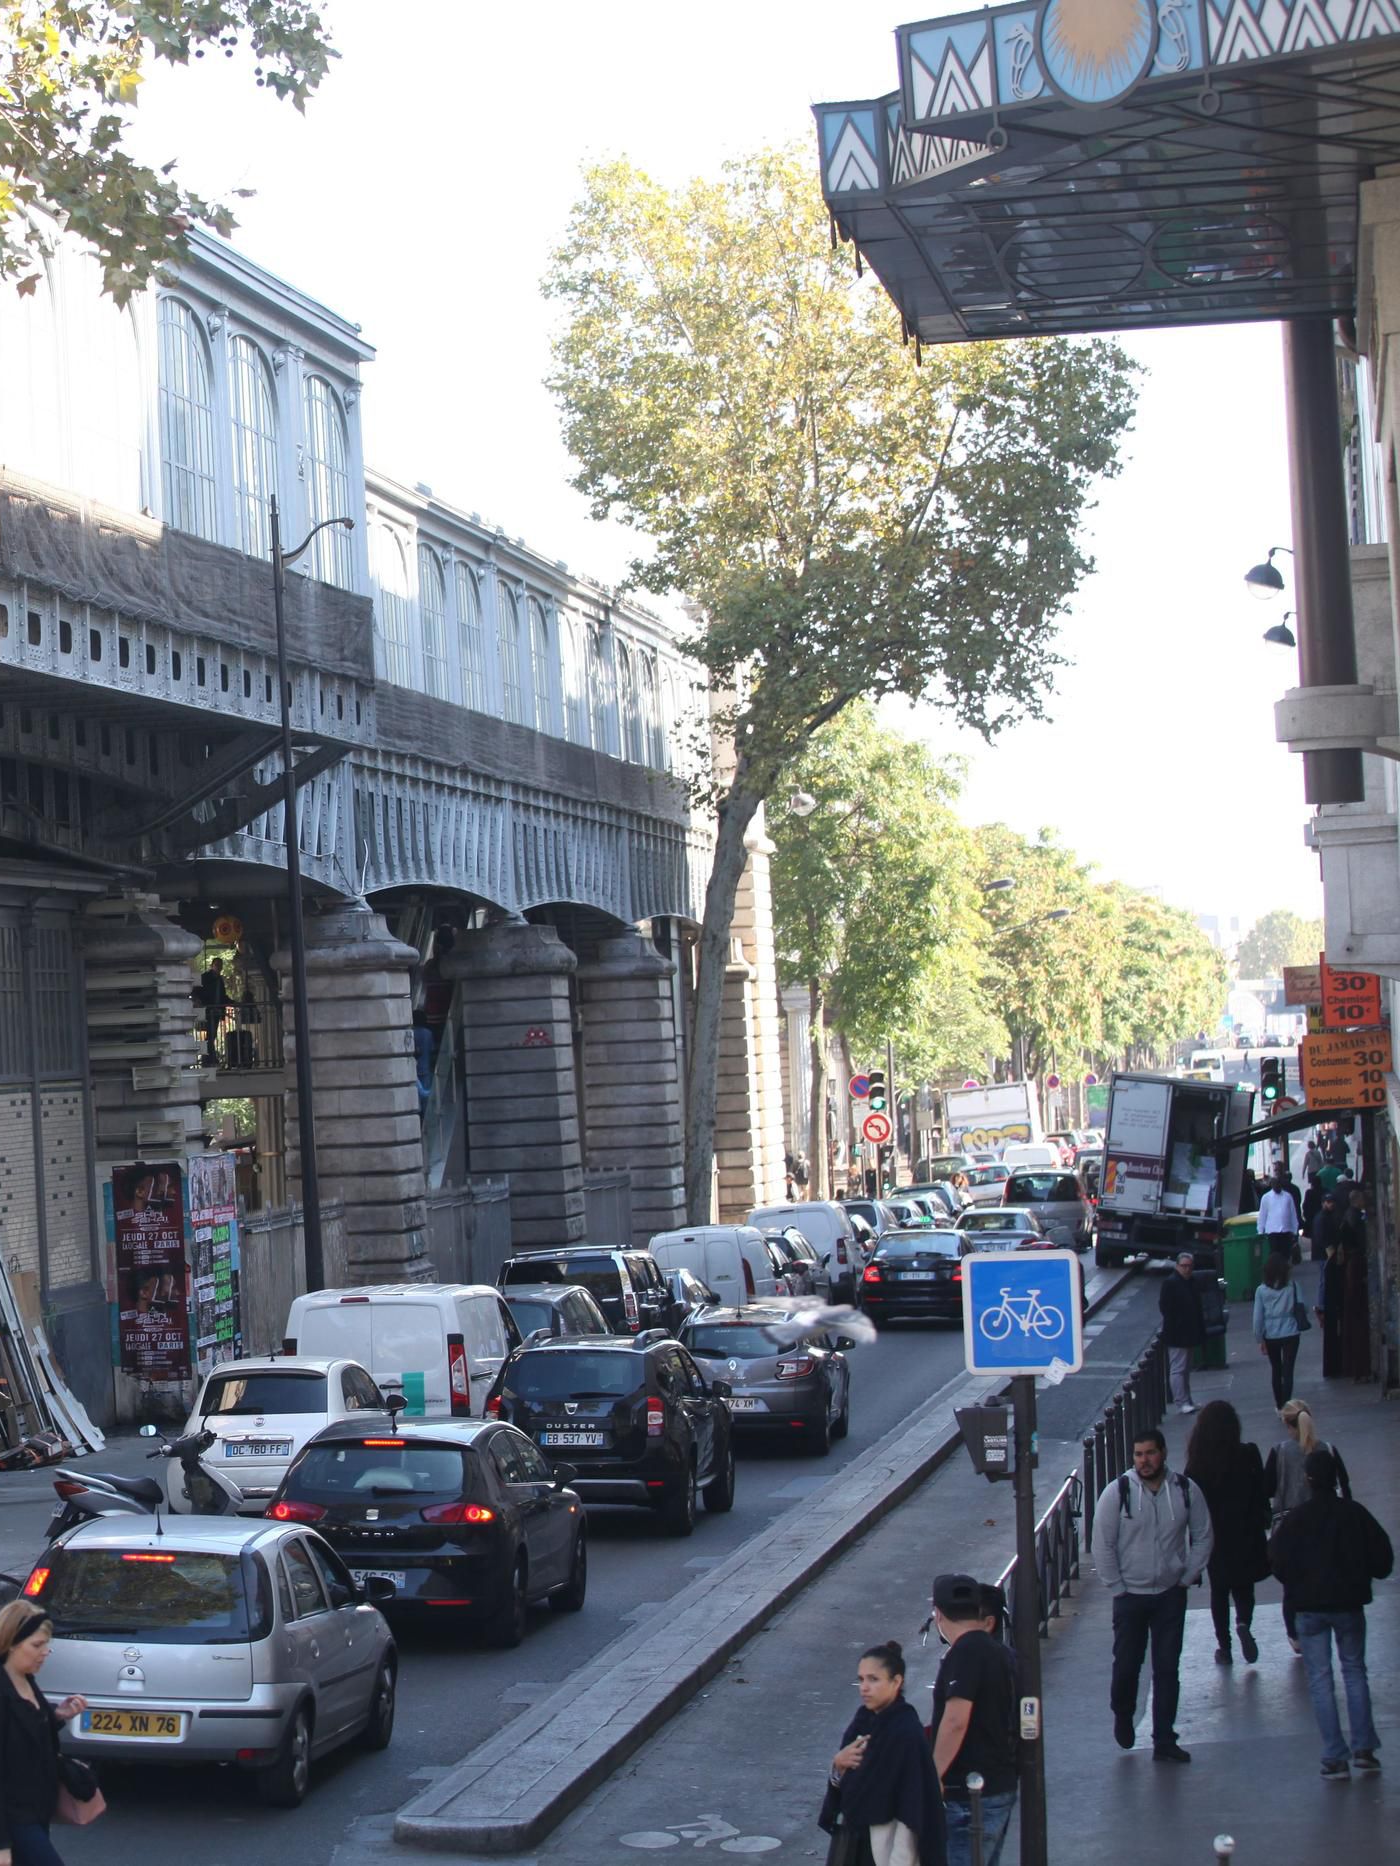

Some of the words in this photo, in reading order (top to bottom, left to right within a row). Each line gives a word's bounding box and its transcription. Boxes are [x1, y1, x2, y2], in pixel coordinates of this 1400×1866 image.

[1327, 1037, 1367, 1052] JAMAIS
[1358, 1068, 1383, 1084] 10
[1359, 1086, 1386, 1103] 10
[122, 1232, 146, 1242] JEUDI
[148, 1232, 159, 1240] 27
[161, 1231, 178, 1240] OCT
[125, 1333, 149, 1342] JEUDI
[151, 1333, 162, 1341] 27
[165, 1332, 182, 1341] OCT
[92, 1714, 122, 1731] 224
[129, 1716, 149, 1733] XN
[156, 1717, 176, 1734] 76
